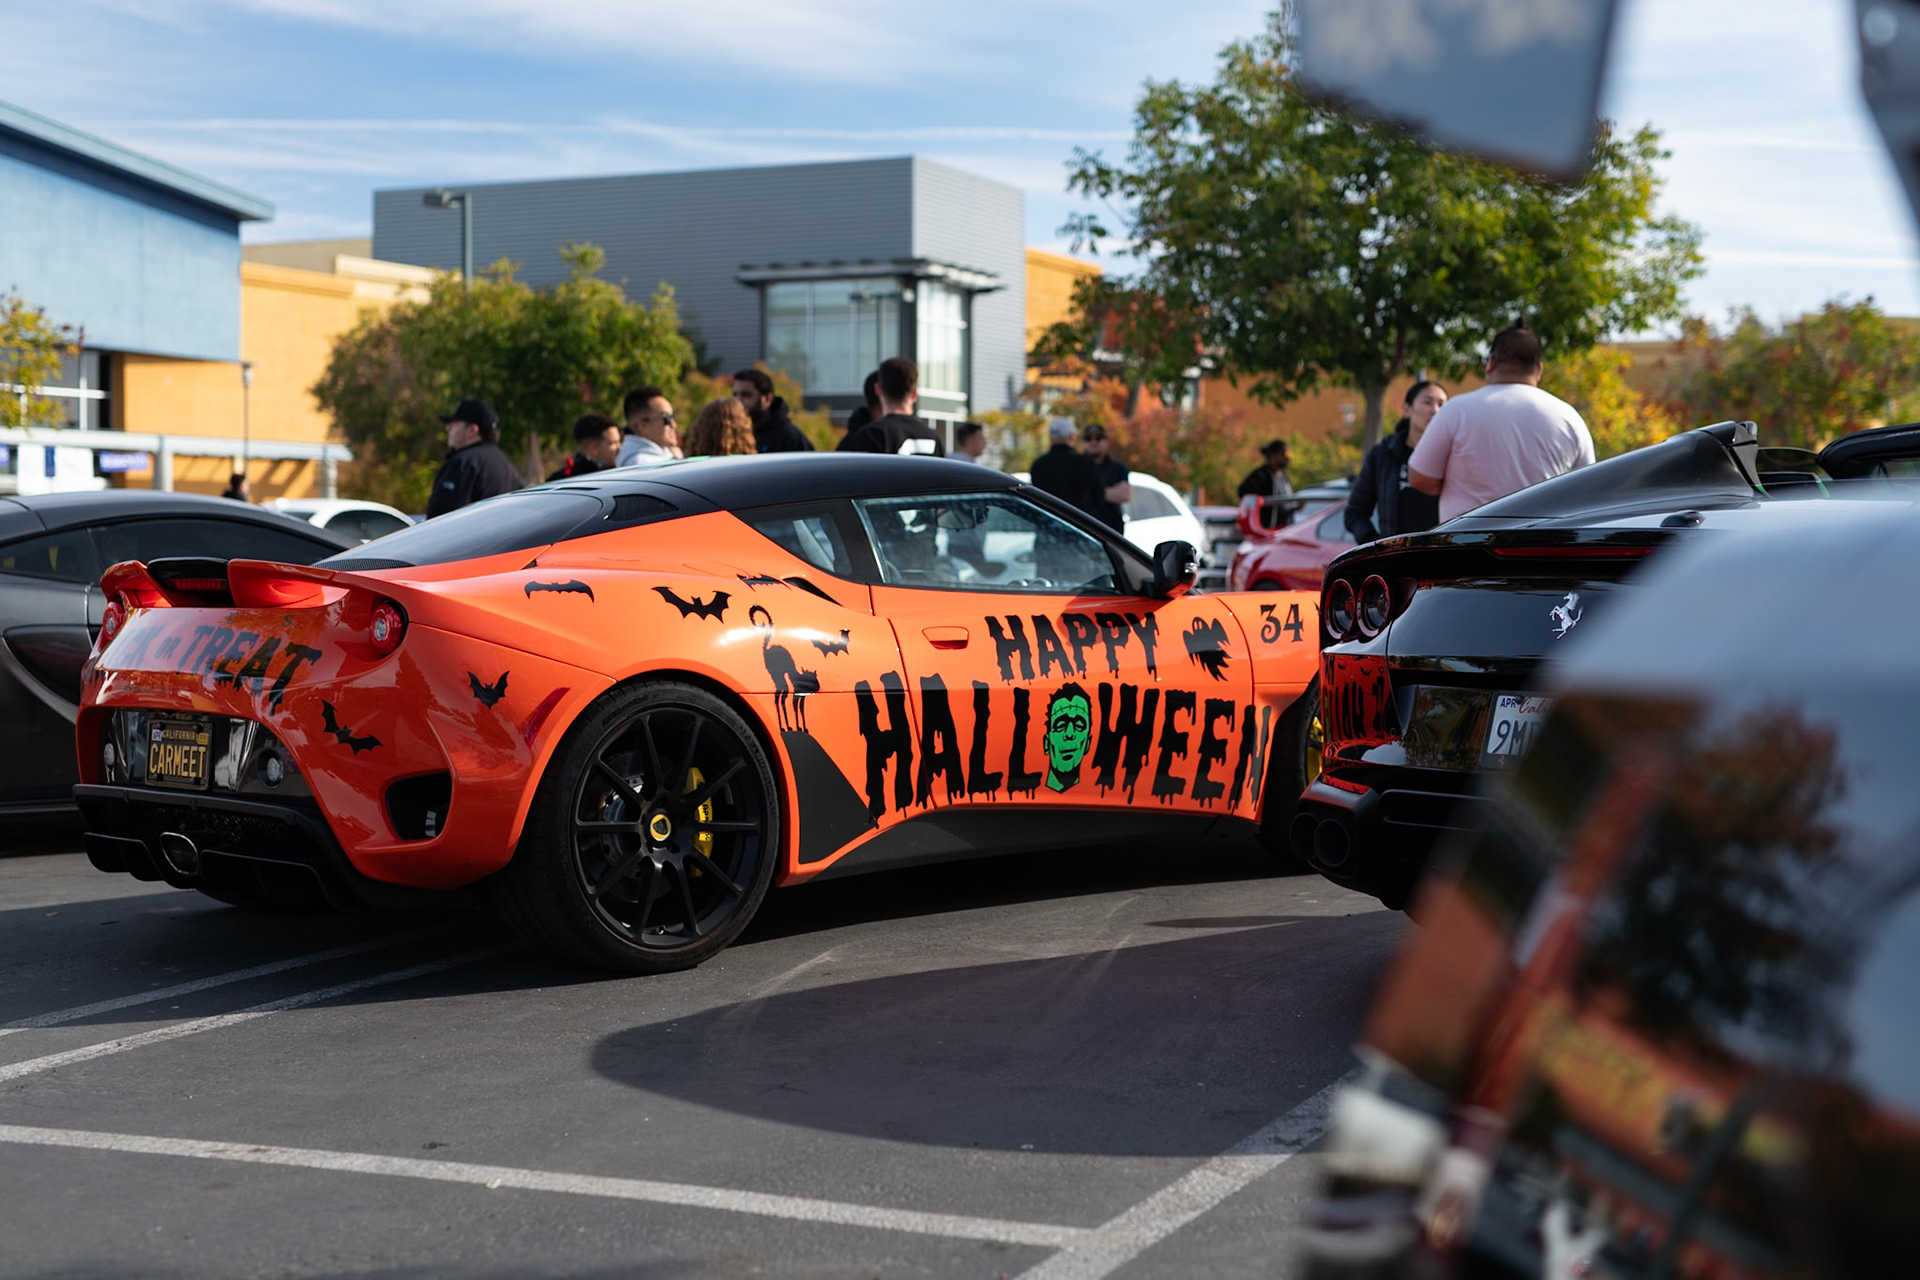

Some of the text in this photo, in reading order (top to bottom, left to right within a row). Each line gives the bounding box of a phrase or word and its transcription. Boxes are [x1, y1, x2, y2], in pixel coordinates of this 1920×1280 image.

[1260, 604, 1304, 643] 34
[985, 612, 1160, 685] HAPPY
[154, 636, 181, 659] OR
[176, 625, 322, 716] TREAT
[1500, 698, 1517, 708] APR
[162, 730, 196, 740] CALIFORNIA
[150, 743, 206, 778] CARMEET
